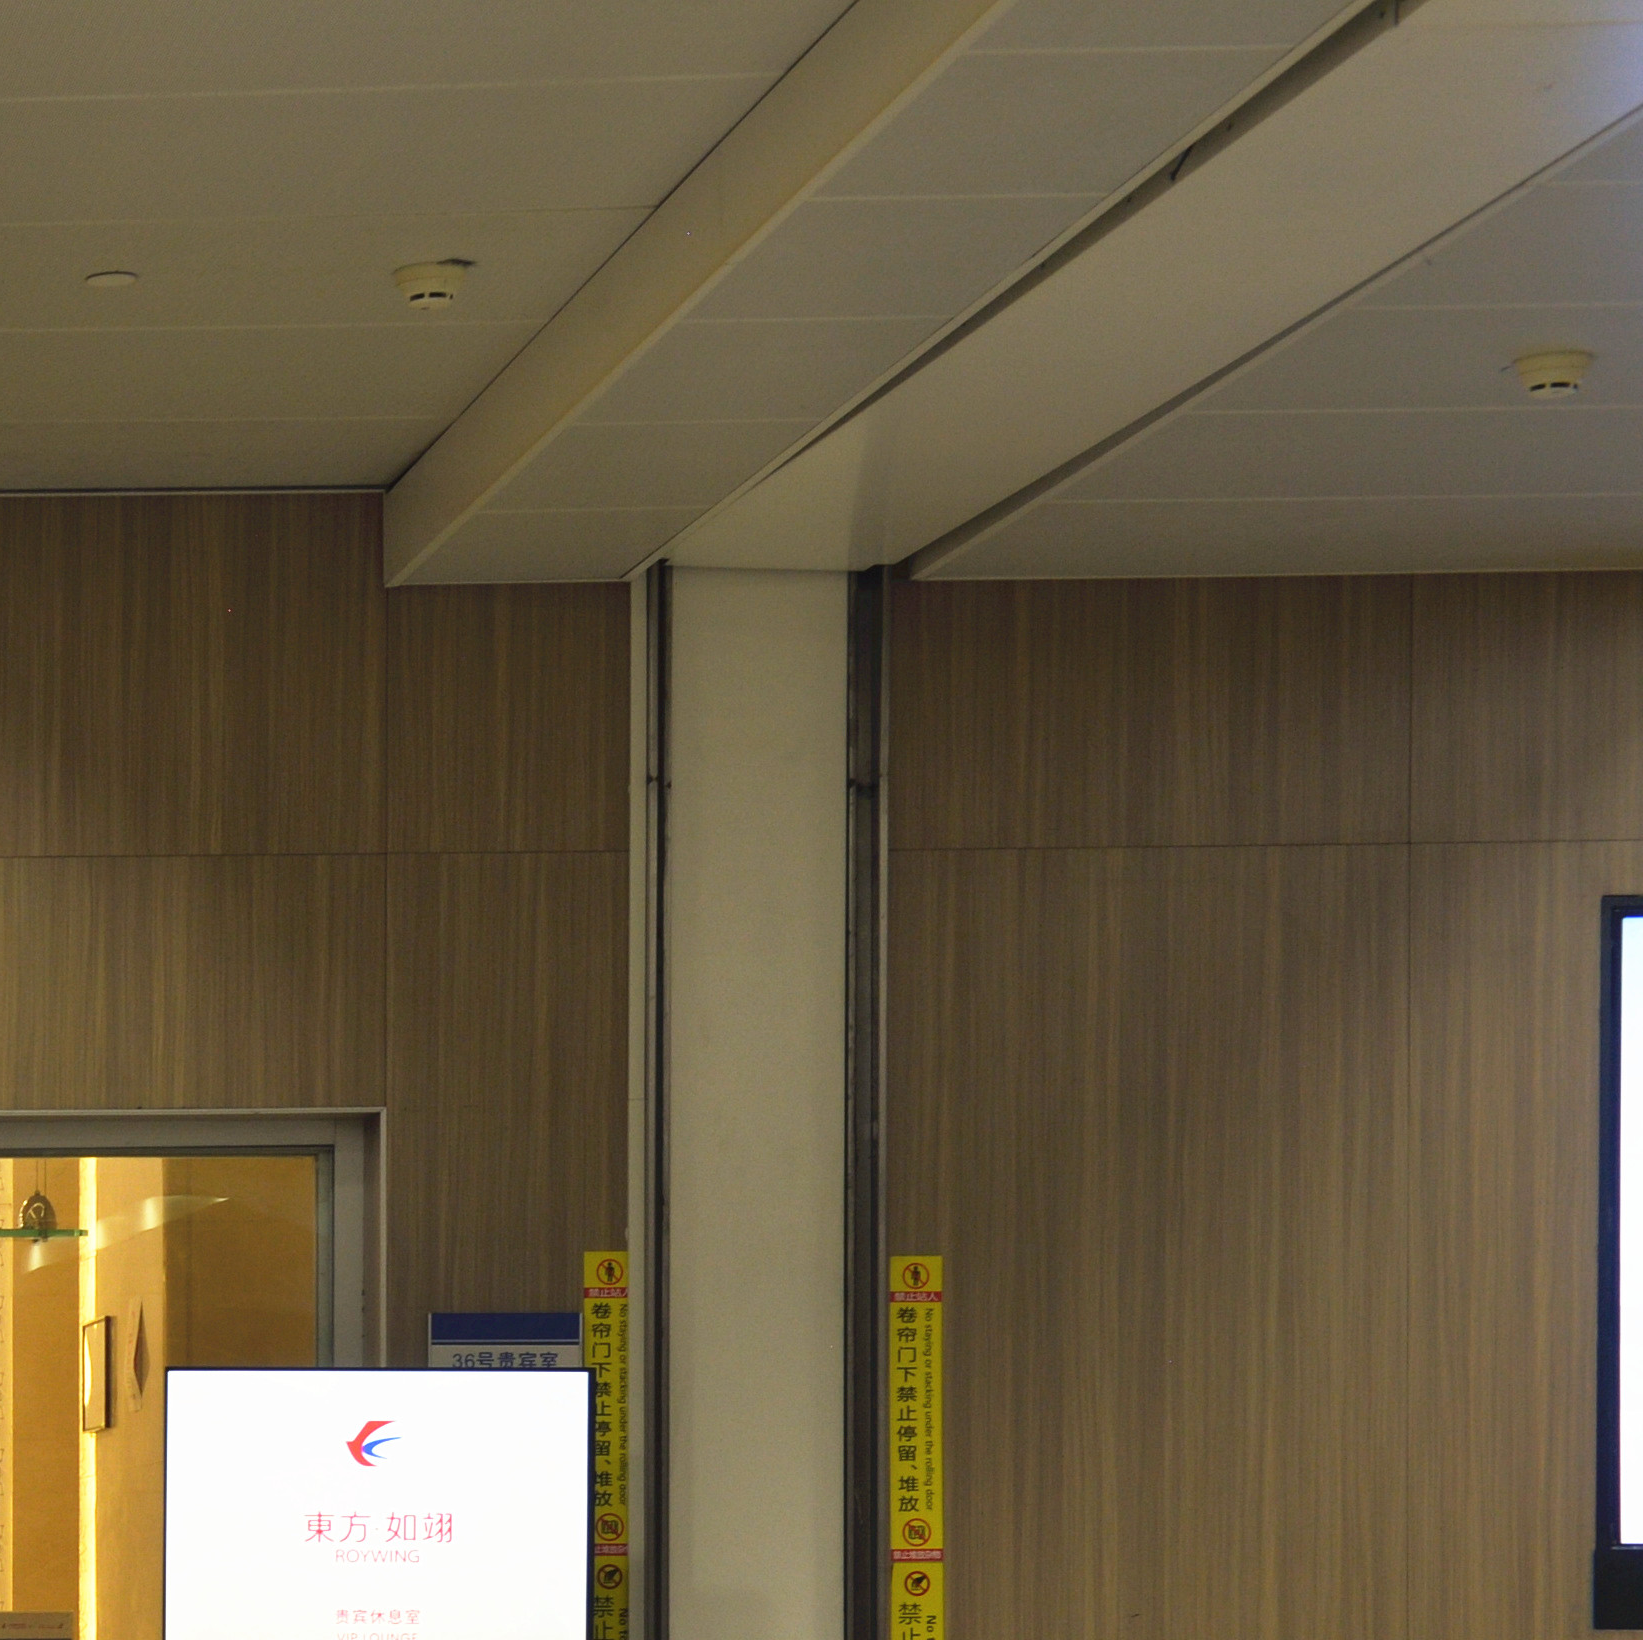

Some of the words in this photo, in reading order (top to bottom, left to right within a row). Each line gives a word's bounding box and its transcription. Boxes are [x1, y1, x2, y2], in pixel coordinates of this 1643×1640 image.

[925, 1307, 935, 1322] No
[452, 1351, 558, 1368] 36号贵宾室
[896, 1306, 920, 1513] 卷帘门下禁止停留、堆放
[925, 1411, 934, 1438] under
[925, 1440, 934, 1456] the
[925, 1488, 934, 1511] door
[334, 1548, 421, 1565] ROYWING
[334, 1608, 421, 1626] 贵宾休息室
[618, 1607, 629, 1627] No
[925, 1614, 937, 1634] No
